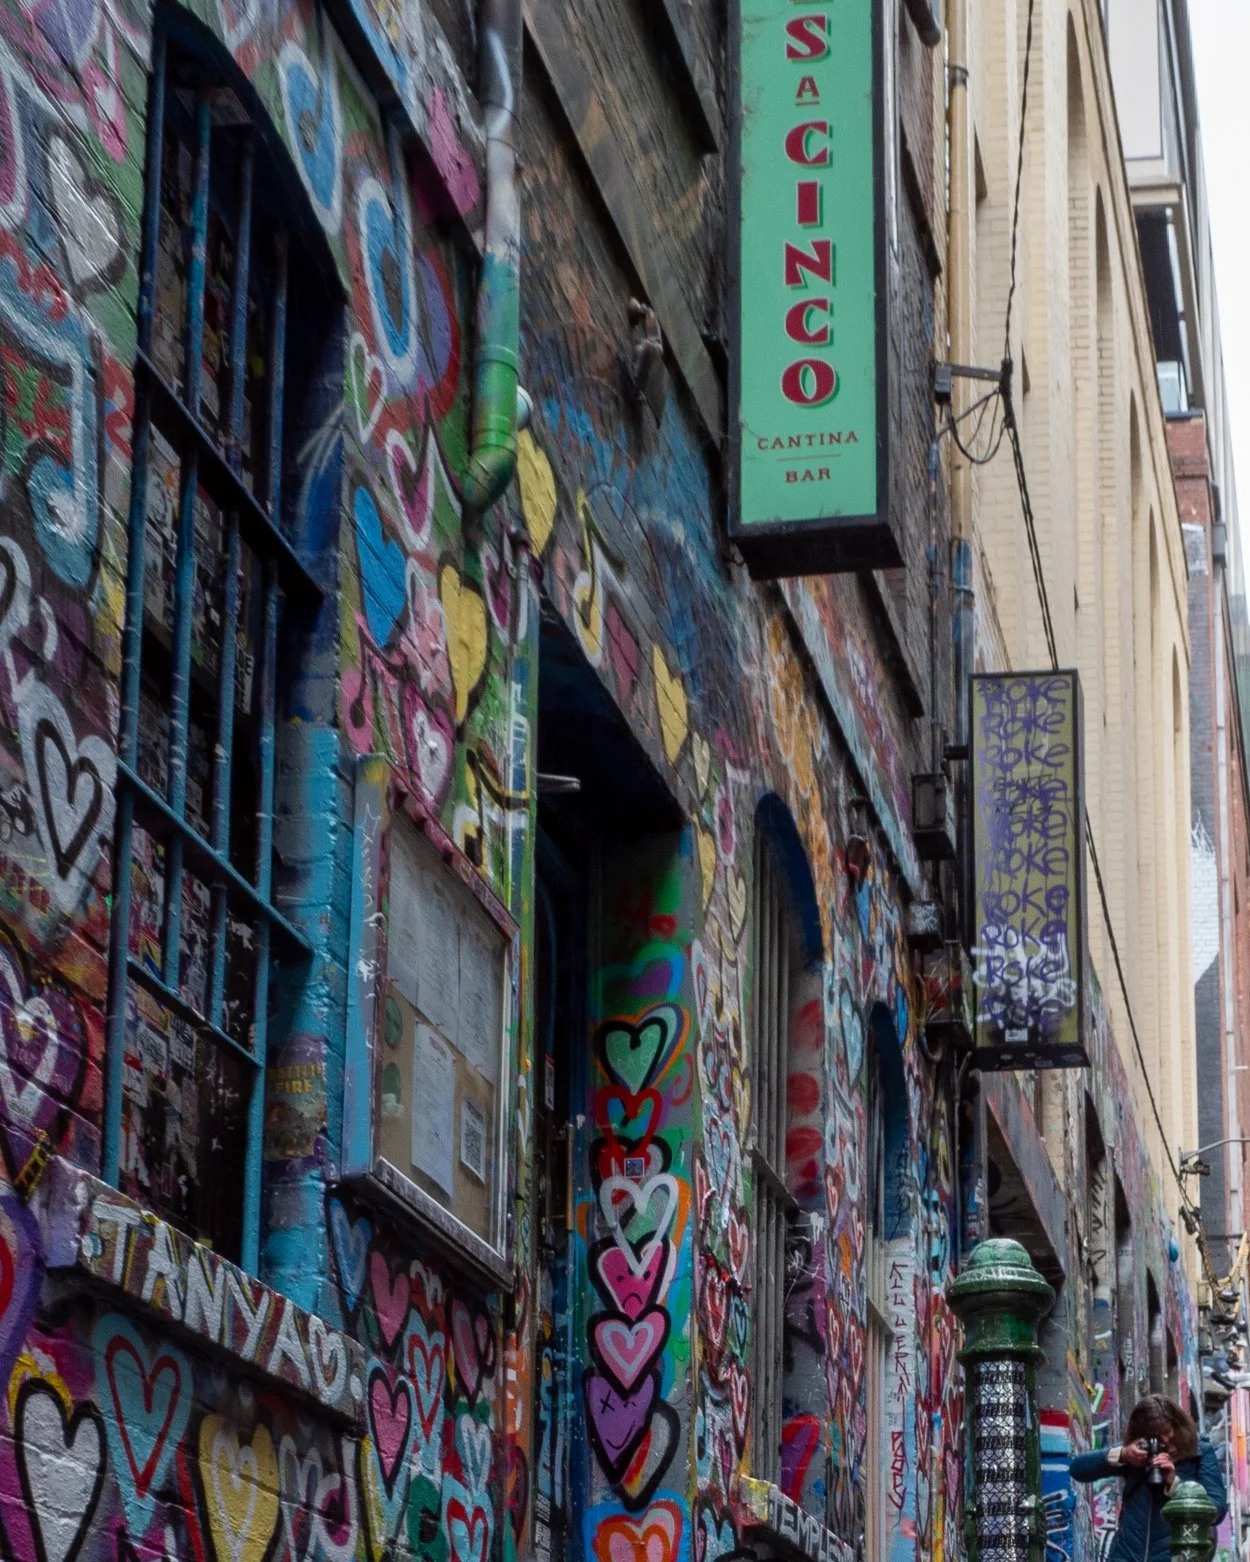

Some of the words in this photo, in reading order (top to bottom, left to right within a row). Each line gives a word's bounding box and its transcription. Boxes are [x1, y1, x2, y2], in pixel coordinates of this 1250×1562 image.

[781, 120, 838, 406] CINCO
[757, 430, 859, 450] CANTINA
[785, 467, 831, 483] BAR
